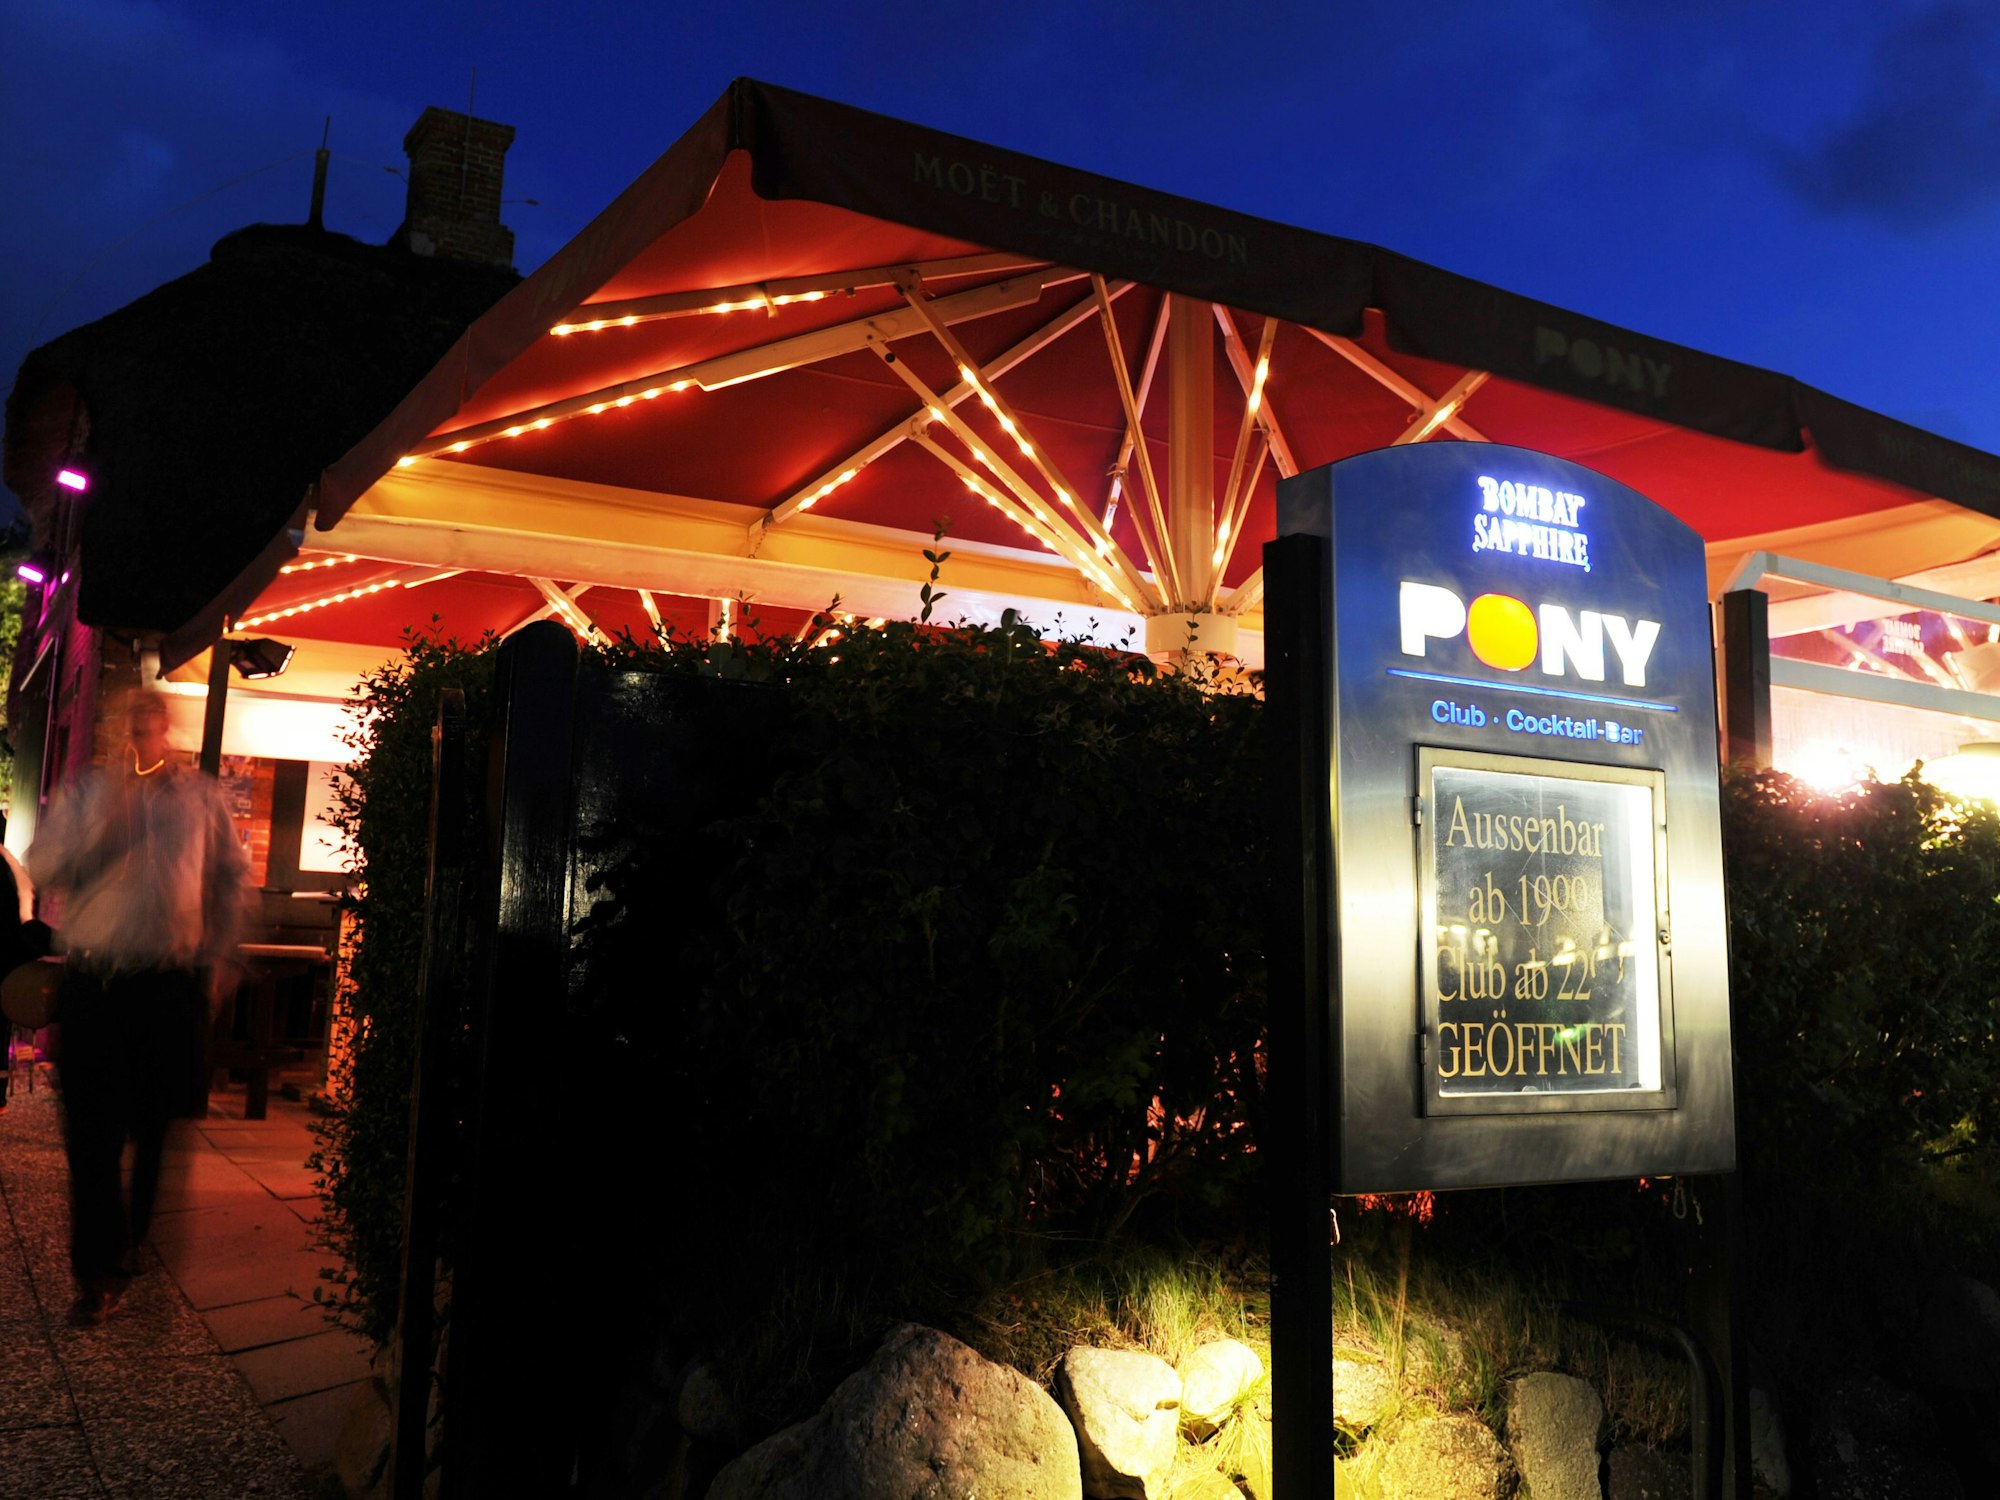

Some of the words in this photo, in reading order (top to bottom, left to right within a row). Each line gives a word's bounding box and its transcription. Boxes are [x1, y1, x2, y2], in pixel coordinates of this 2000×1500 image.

[912, 151, 1025, 209] MOËT
[1039, 190, 1059, 220] &
[1068, 194, 1248, 264] CHANDON
[1535, 325, 1673, 398] PONY
[1477, 475, 1586, 528] BOMBAY
[1472, 514, 1592, 573] SAPPHIRE
[1399, 580, 1662, 688] PONY
[1430, 699, 1487, 728] Club
[1505, 709, 1644, 745] Cocktail-Bar
[1445, 794, 1605, 857] Aussenbar
[1468, 871, 1506, 924] ab
[1437, 945, 1507, 1002] Club
[1514, 947, 1549, 1001] ab
[1438, 1009, 1627, 1079] GEÖFFNET
